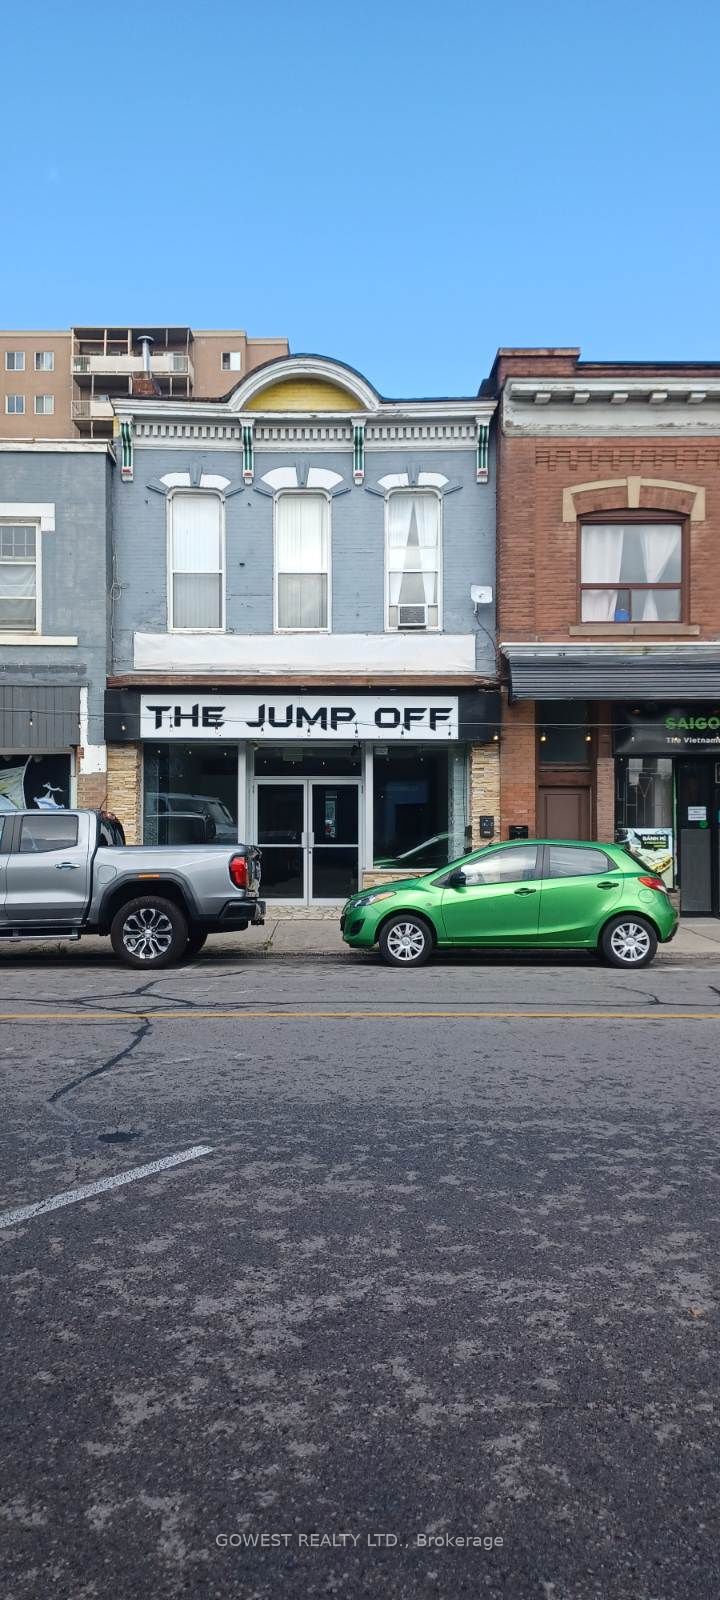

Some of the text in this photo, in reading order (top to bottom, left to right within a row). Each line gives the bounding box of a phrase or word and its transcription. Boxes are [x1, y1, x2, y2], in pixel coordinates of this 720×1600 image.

[146, 703, 454, 732] THE JUMP OFF
[665, 736, 682, 744] The
